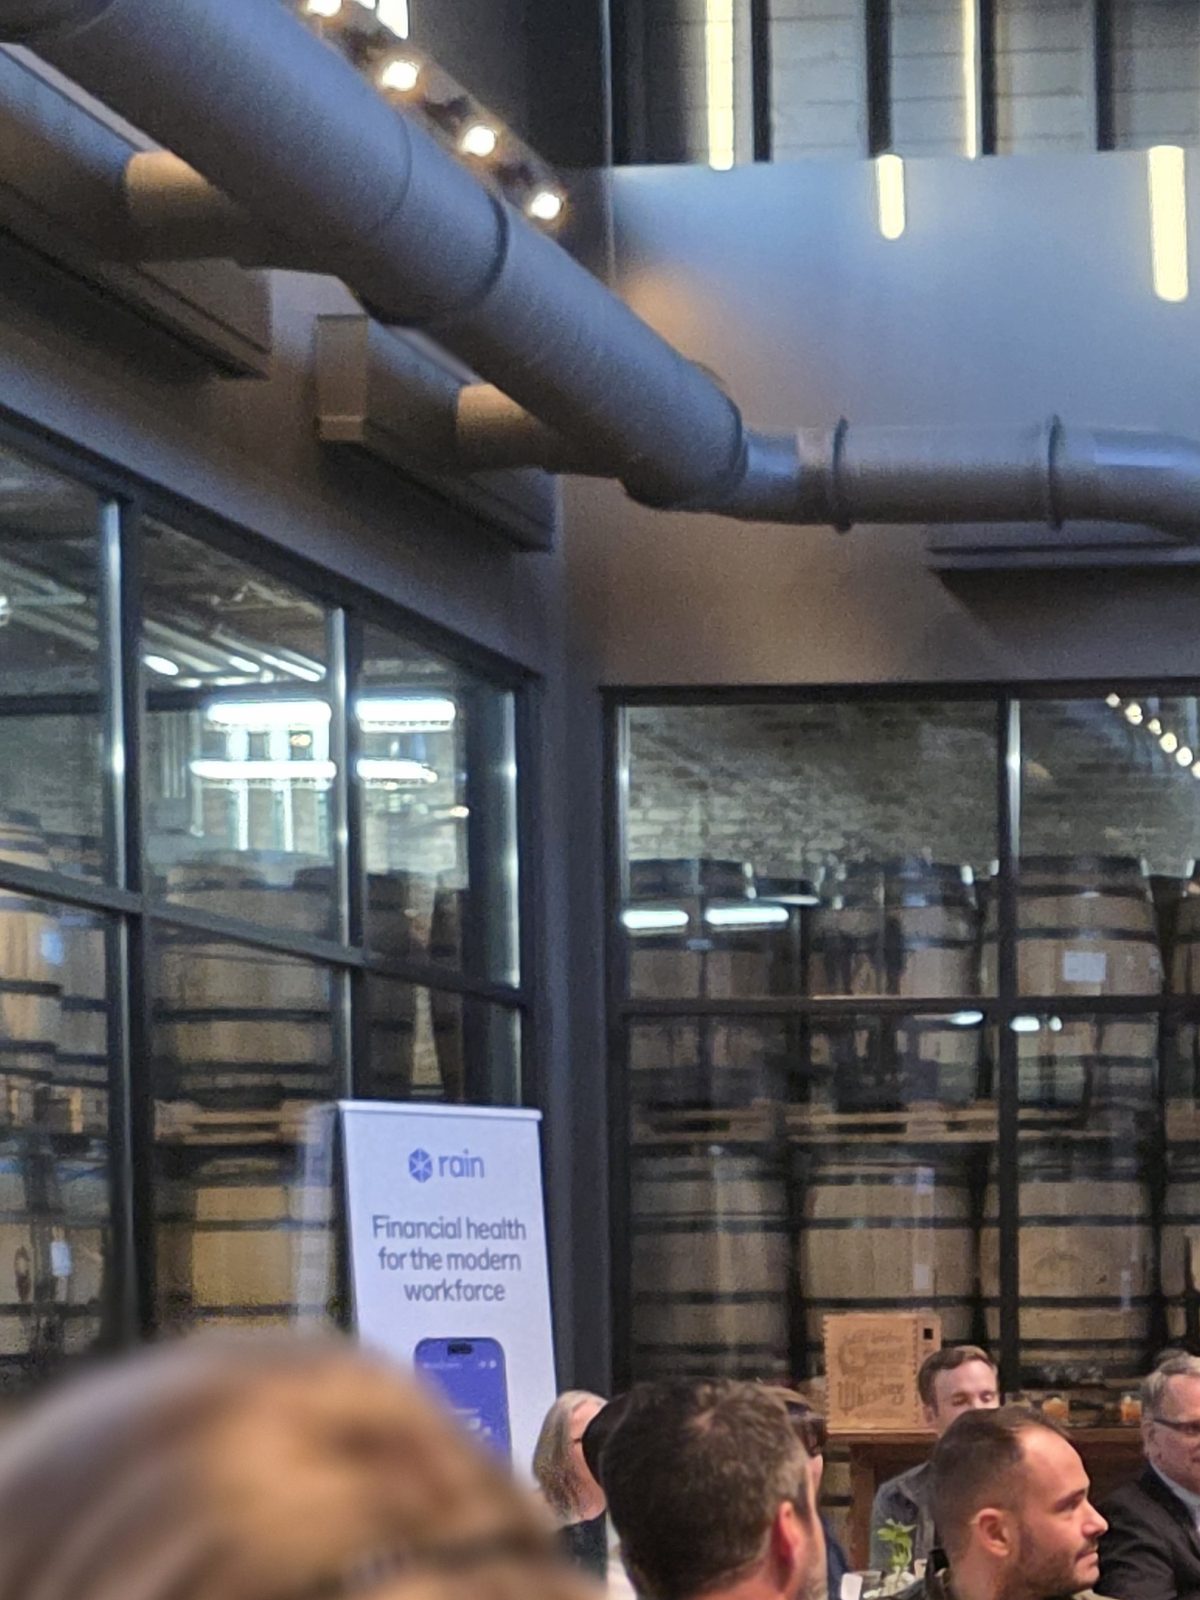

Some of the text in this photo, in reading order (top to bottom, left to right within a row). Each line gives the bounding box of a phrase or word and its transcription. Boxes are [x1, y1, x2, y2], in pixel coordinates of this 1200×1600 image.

[437, 1148, 485, 1178] rain
[372, 1214, 526, 1241] Financial health
[378, 1246, 521, 1271] for the modern
[403, 1277, 506, 1302] workforce
